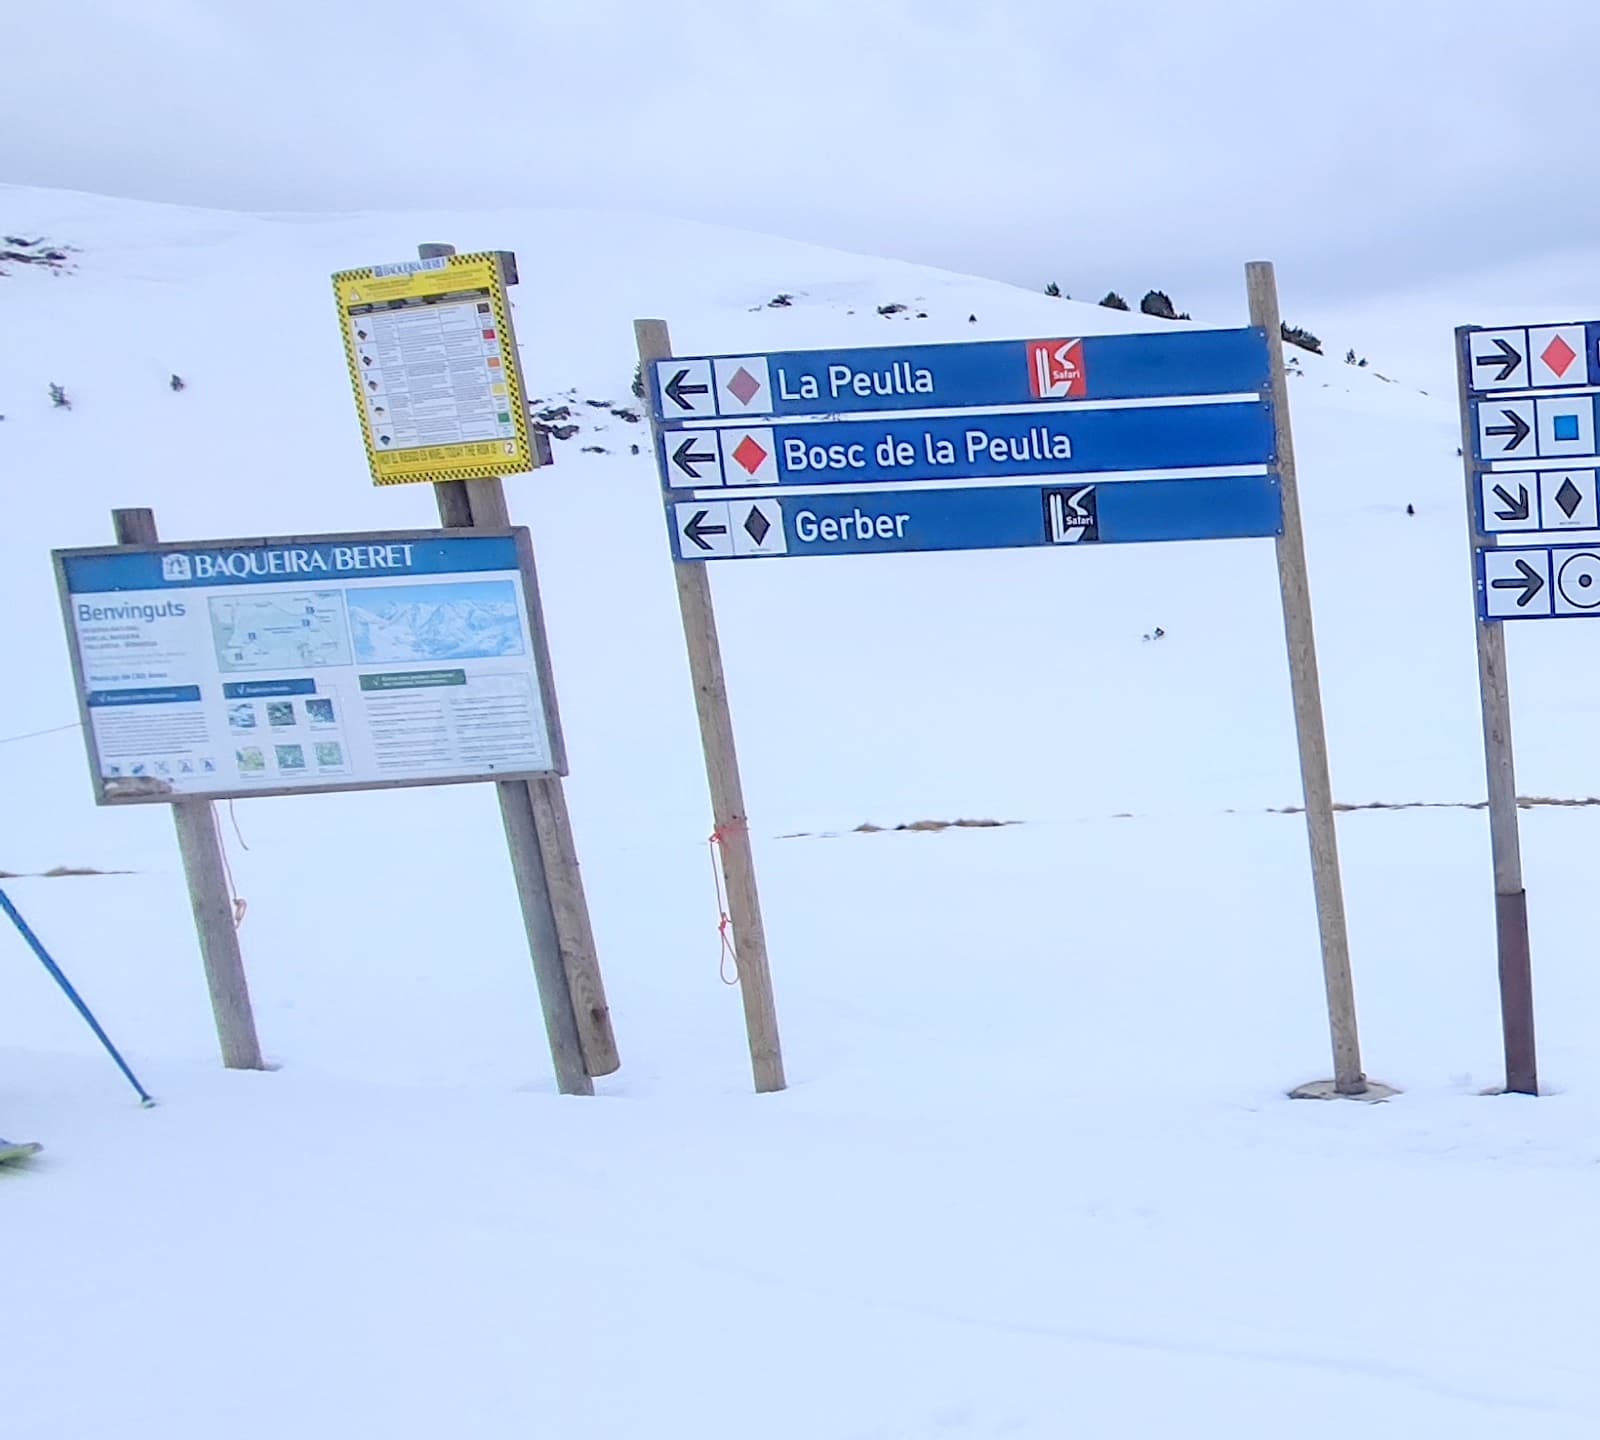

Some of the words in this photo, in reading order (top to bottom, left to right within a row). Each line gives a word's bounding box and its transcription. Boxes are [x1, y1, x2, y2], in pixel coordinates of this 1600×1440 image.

[778, 368, 819, 400] La
[828, 361, 934, 398] Peulla
[1053, 368, 1081, 380] Safari
[784, 439, 866, 470] Bosc
[876, 434, 914, 466] de
[924, 432, 955, 465] la
[965, 428, 1072, 463] Peulla
[795, 508, 910, 542] Gerber
[1066, 513, 1094, 526] Safari
[195, 544, 414, 578] BAQUEIRA/BERET
[78, 600, 186, 622] Benvinguts
